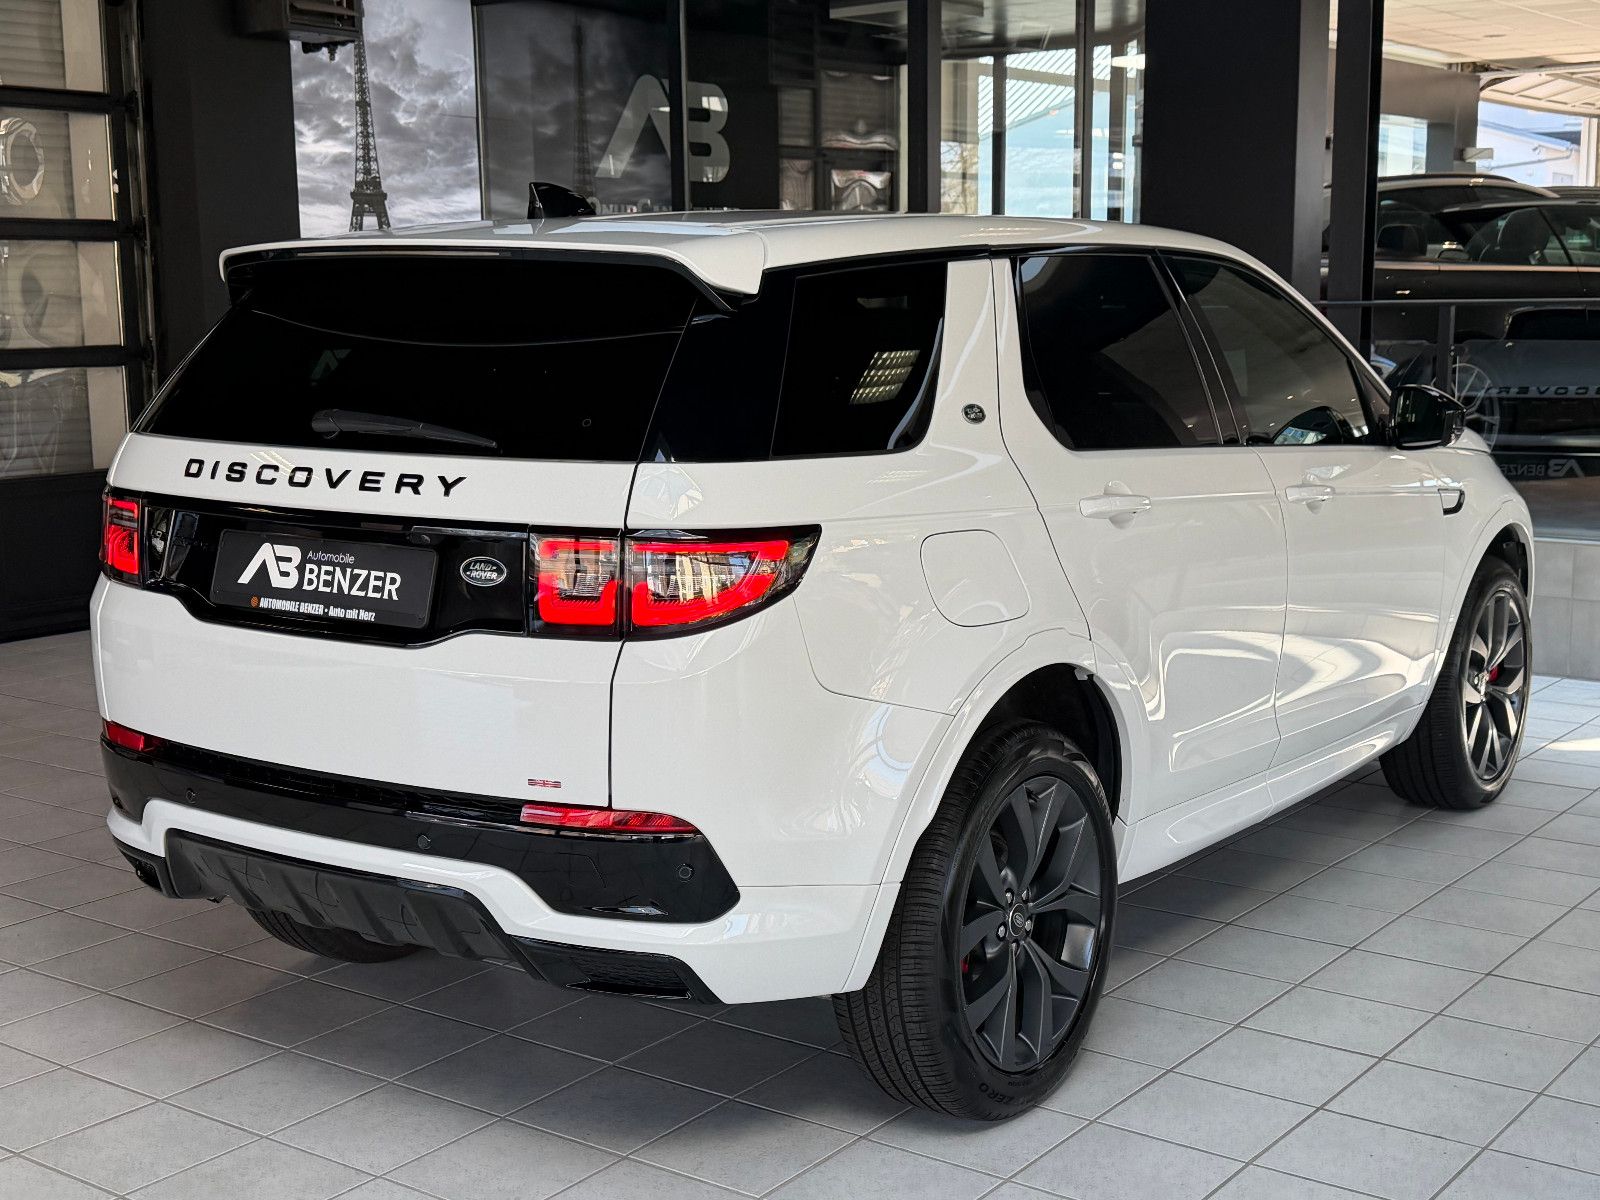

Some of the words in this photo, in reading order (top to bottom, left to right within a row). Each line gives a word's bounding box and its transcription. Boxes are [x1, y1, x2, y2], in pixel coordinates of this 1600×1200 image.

[183, 458, 467, 498] DISCOVERY
[237, 542, 302, 589] AB
[306, 550, 355, 564] Automobile
[302, 563, 402, 601] BENZER
[259, 597, 300, 613] AUTOMOBILE
[300, 602, 324, 615] BENZER
[328, 605, 345, 618] Auto
[345, 608, 358, 620] mit
[358, 609, 376, 622] Herz
